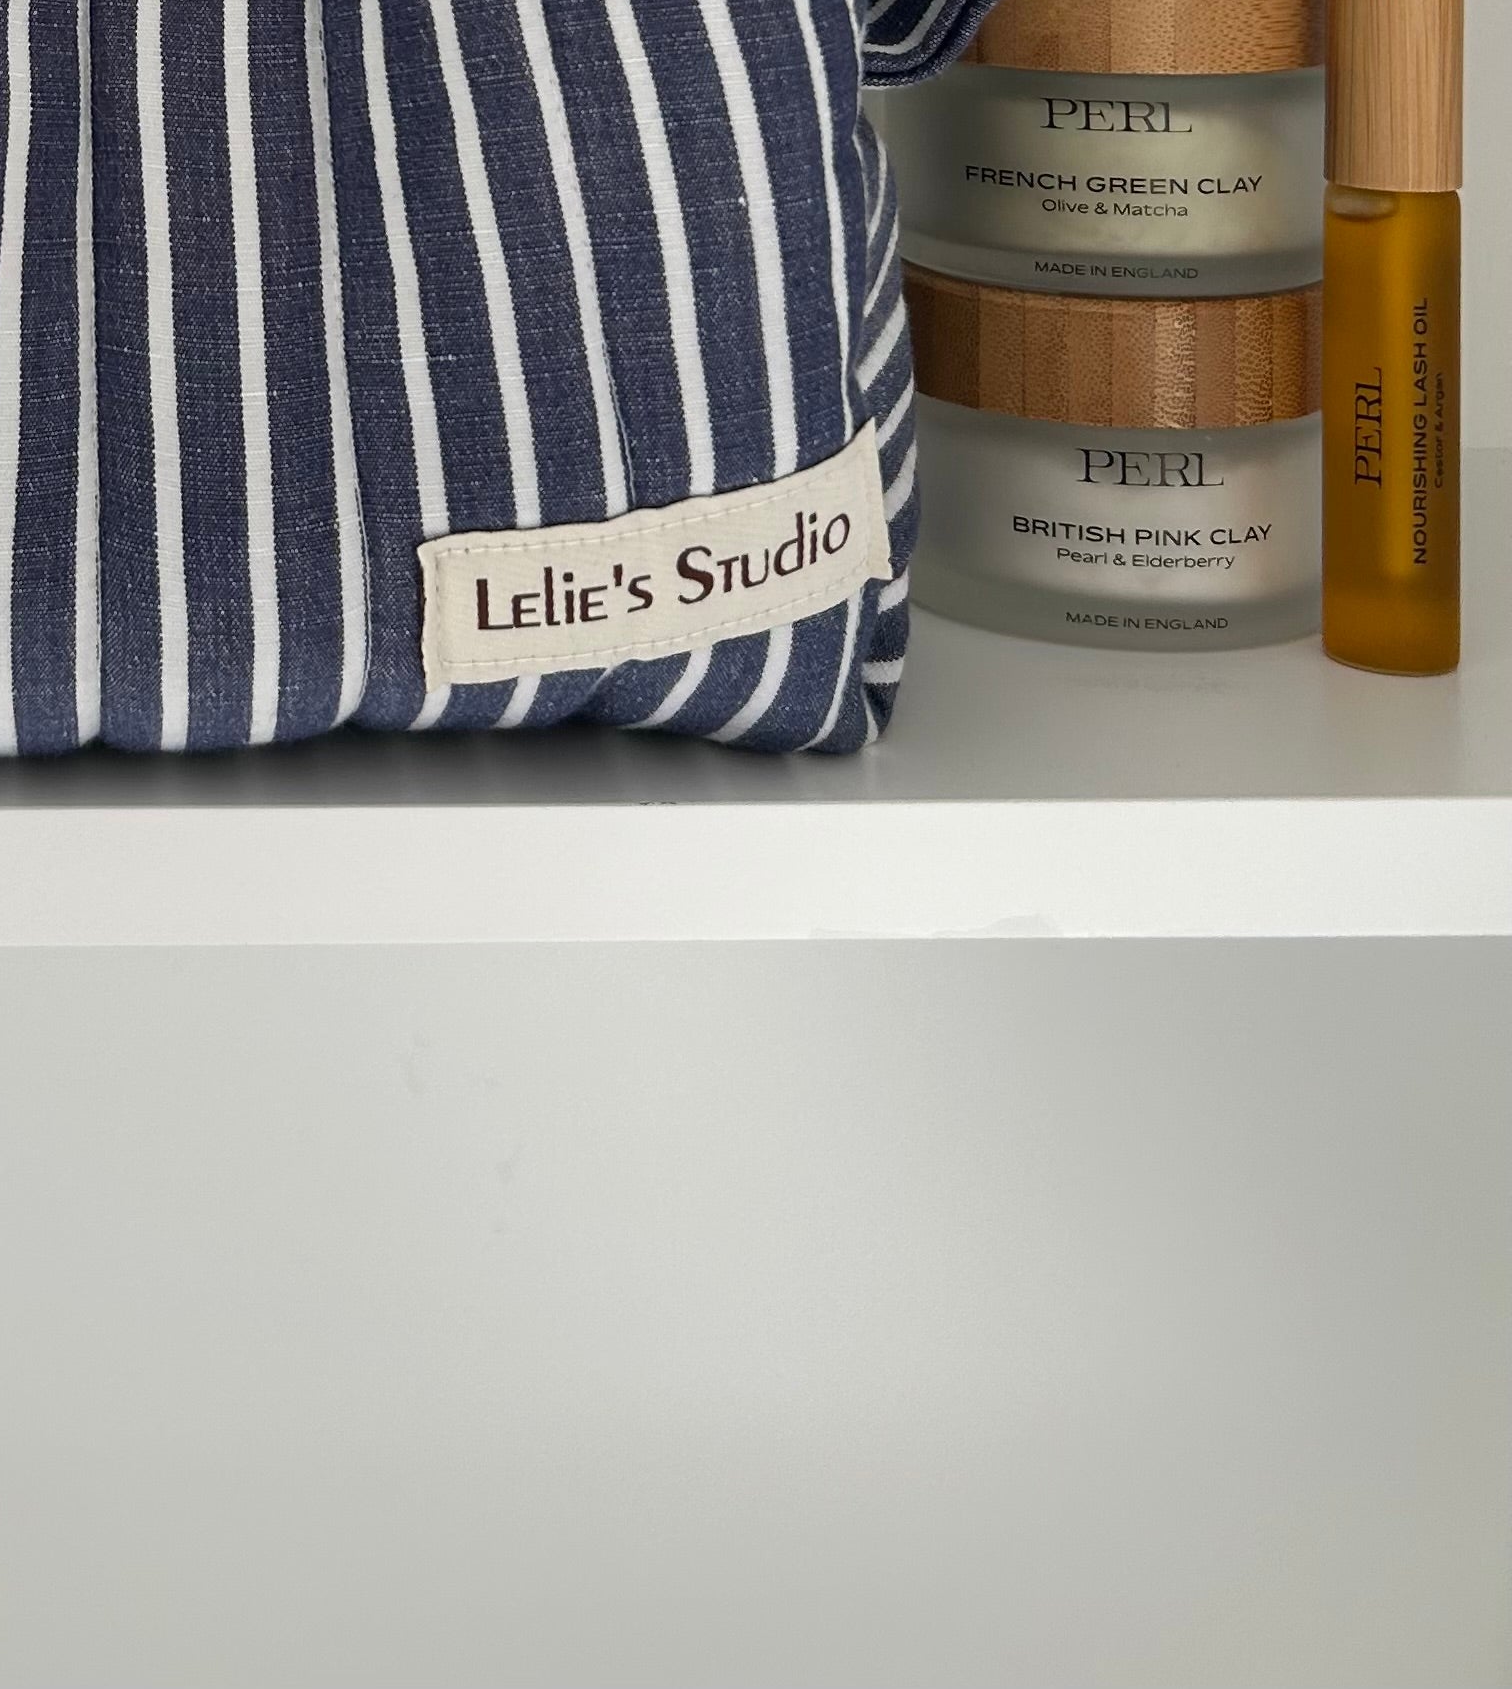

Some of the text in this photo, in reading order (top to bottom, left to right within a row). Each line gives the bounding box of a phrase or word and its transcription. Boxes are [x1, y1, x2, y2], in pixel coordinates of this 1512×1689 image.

[1040, 97, 1193, 133] PERL
[965, 165, 1263, 195] FRENCH GREEN CLAY
[1041, 198, 1189, 218] Olive & Matcha
[1035, 260, 1199, 280] MADE IN ENGLAND
[1354, 366, 1383, 490] PERL
[1413, 297, 1428, 565] NOURISHING LASH OIL
[1434, 422, 1444, 434] &
[1074, 447, 1225, 488] PERL
[1013, 515, 1272, 547] BRITISH PINK CLAY
[1056, 547, 1236, 570] Pearl & Elderberry
[1065, 611, 1229, 630] MADE IN ENGLAND
